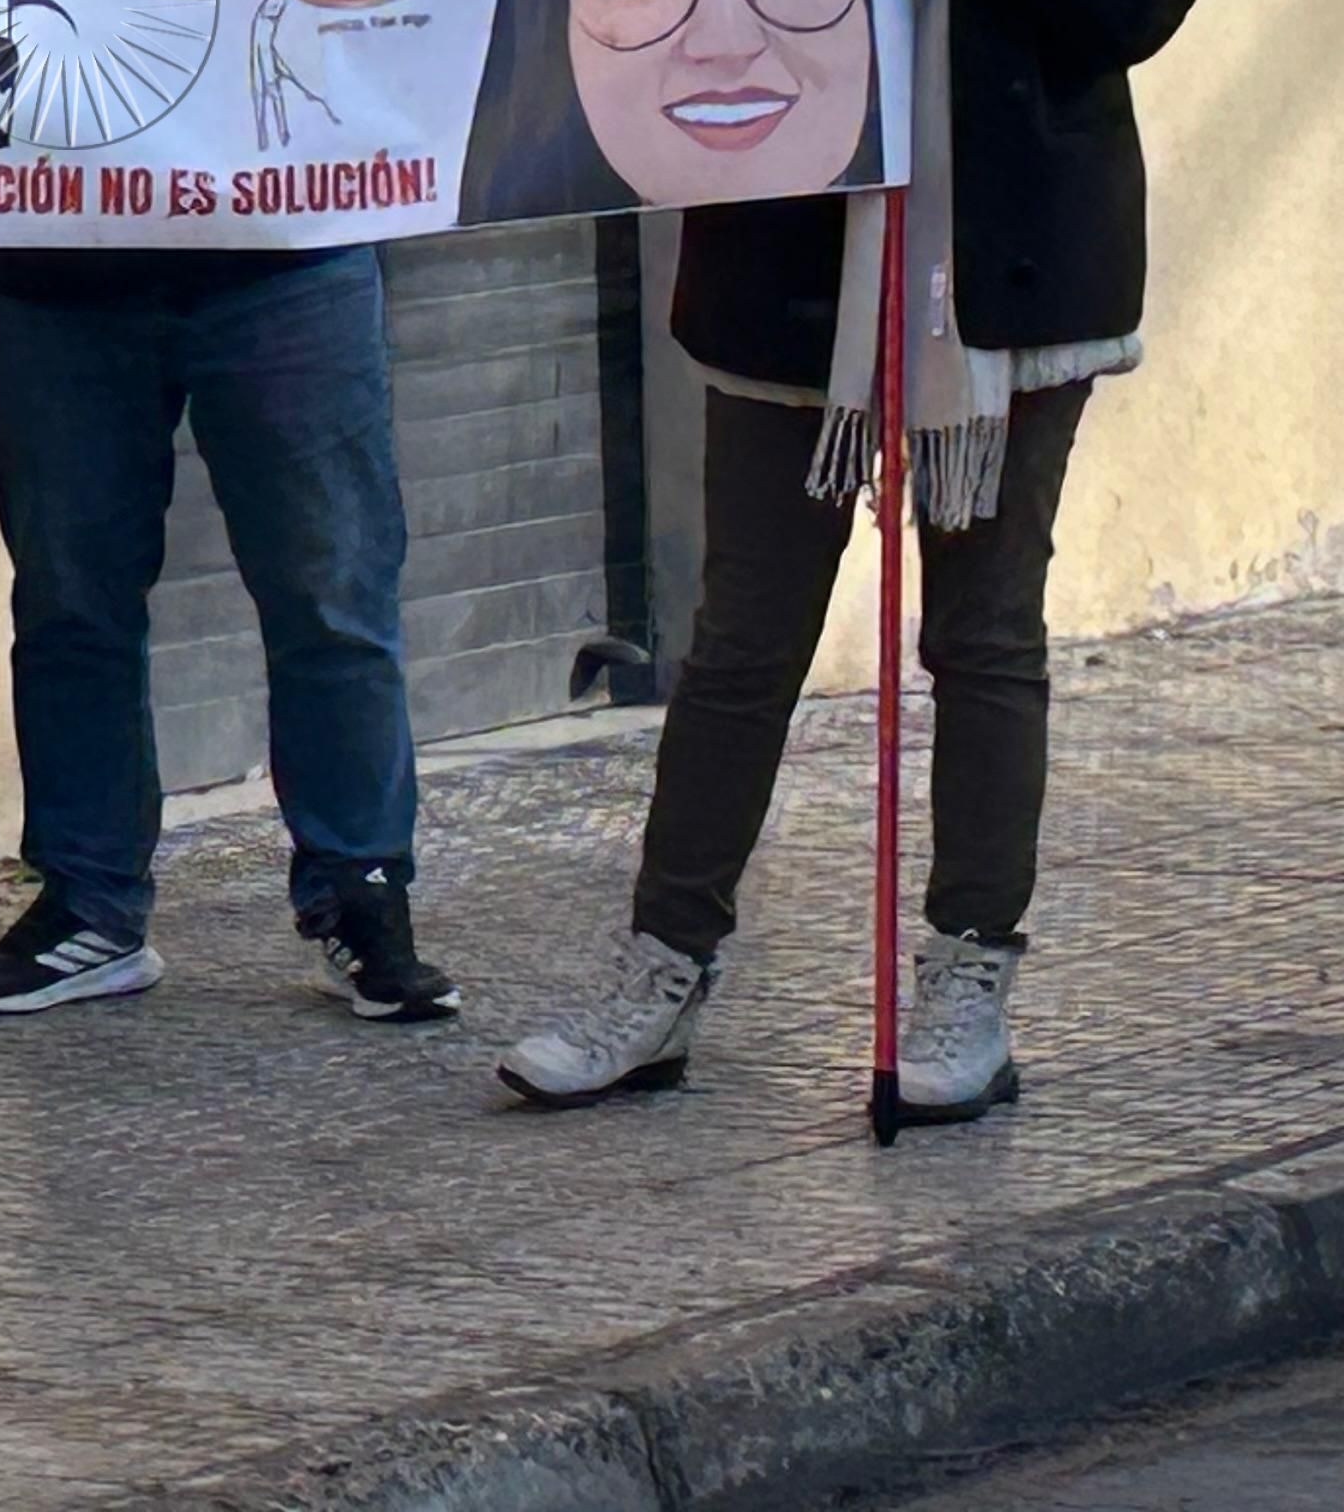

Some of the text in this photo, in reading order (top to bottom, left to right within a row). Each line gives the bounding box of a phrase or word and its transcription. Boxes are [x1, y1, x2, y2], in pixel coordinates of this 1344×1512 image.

[100, 162, 154, 216] NO
[168, 163, 218, 218] ES
[231, 148, 439, 218] SOLUCIÓN!
